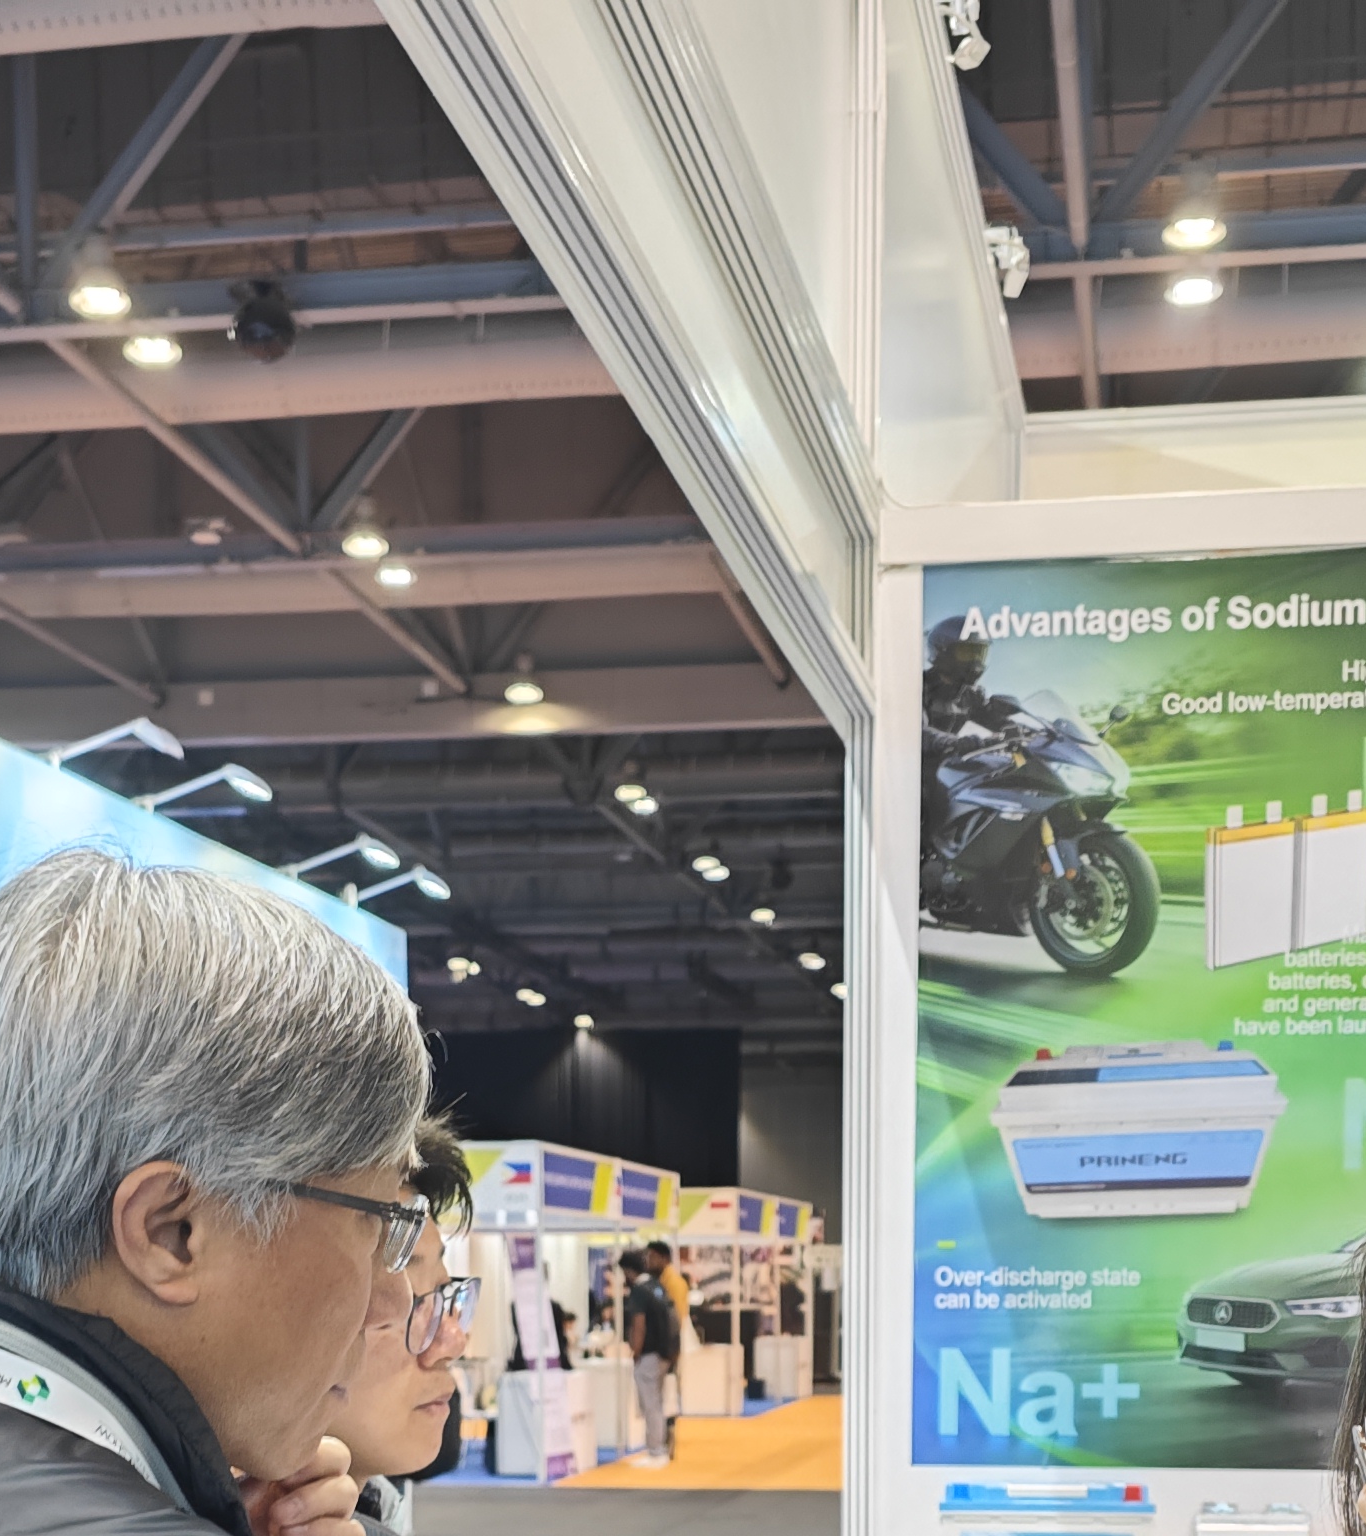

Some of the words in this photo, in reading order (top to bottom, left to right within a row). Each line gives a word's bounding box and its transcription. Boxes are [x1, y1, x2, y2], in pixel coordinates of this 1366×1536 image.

[960, 601, 1172, 643] Advantages
[1181, 597, 1219, 632] of
[1228, 593, 1366, 629] Sodium
[1162, 694, 1222, 715] Good
[1269, 970, 1357, 992] batteries,
[1263, 995, 1298, 1014] and
[1234, 1018, 1280, 1036] have
[1285, 1017, 1332, 1035] been
[935, 1267, 1086, 1289] Over-discharge
[1092, 1268, 1140, 1287] state
[935, 1292, 970, 1309] can
[975, 1290, 1000, 1309] be
[1004, 1289, 1091, 1309] activated
[937, 1348, 1140, 1437] Na+
